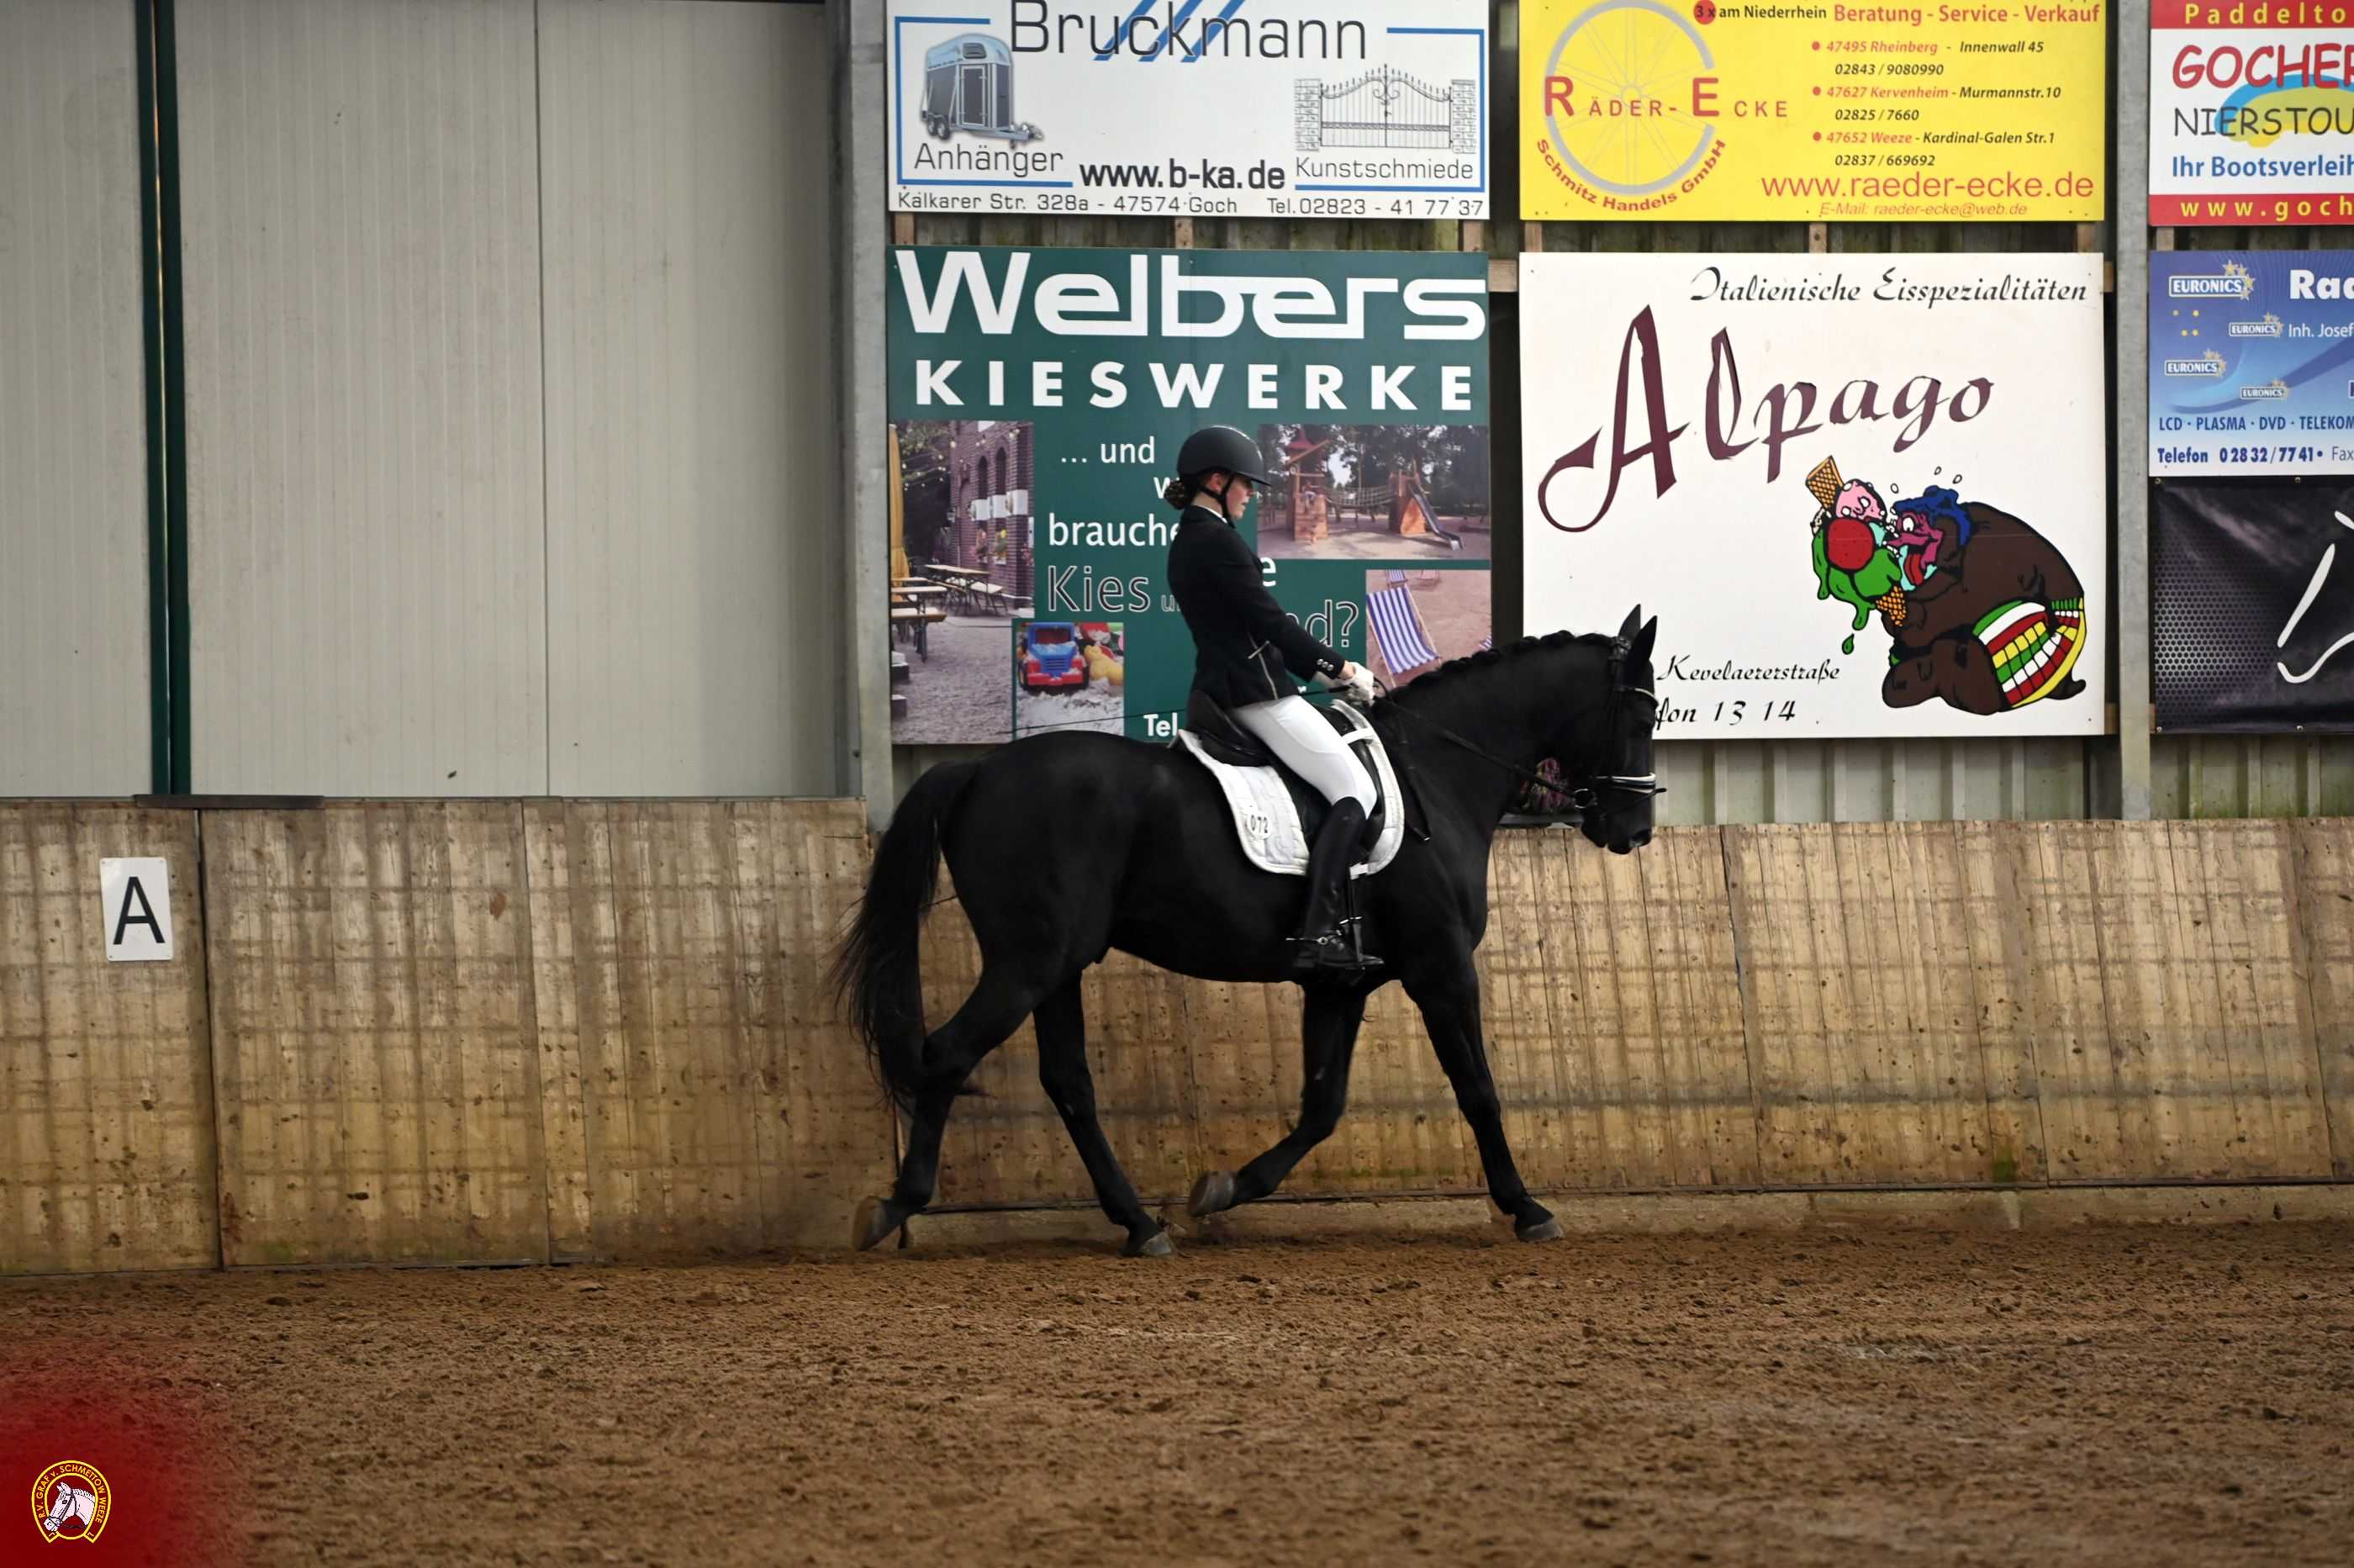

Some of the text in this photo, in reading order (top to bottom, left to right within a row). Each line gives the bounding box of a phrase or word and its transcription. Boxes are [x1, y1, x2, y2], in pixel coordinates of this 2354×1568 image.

[1697, 5, 1703, 18] 3
[1708, 8, 1716, 17] x
[1719, 8, 1740, 18] am
[1744, 5, 1827, 18] Niederrhein
[1834, 4, 1922, 26] Beratung
[1939, 5, 2008, 23] Service
[2024, 4, 2100, 23] Verkauf
[2185, 3, 2346, 24] Paddelto
[1011, 0, 1365, 59] Bruckmann
[1827, 41, 1867, 52] 47495
[1871, 40, 1938, 55] Rheinberg
[1960, 41, 2024, 53] Innenwall
[2028, 41, 2045, 52] 45
[1835, 64, 1875, 75] 02843
[1887, 64, 1944, 75] 9080990
[1827, 87, 1867, 98] 47627
[1871, 86, 1949, 98] Kervenheim
[1835, 109, 1875, 120] 02825
[1887, 109, 1919, 120] 7660
[1827, 132, 1867, 143] 47652
[1871, 132, 1913, 144] Weeze
[1923, 131, 2023, 144] Kardinal-Galen
[915, 143, 1063, 177] Anhänger
[1296, 156, 1473, 179] Kunstschmiede
[1835, 155, 1876, 166] 02837
[1887, 155, 1935, 166] 669692
[2172, 156, 2204, 177] Ihr
[1079, 158, 1285, 189] www.b-ka.de
[1538, 139, 1726, 211] Schmitz Handels GmbH
[1761, 171, 2094, 198] www.raeder-ecke.de
[898, 192, 981, 209] Kalkarer
[990, 194, 1026, 209] Str.
[1037, 194, 1089, 210] 328a
[1114, 197, 1180, 211] 47574
[1190, 197, 1238, 213] Goch
[1391, 200, 1413, 214] 41
[1425, 200, 1449, 215] 77
[1459, 200, 1483, 215] 37
[1820, 203, 2027, 217] E-Mail: raeder-ecke@web.de
[2180, 195, 2353, 221] www.goch
[895, 250, 1486, 341] Welbers
[1690, 267, 2087, 309] Italienische Eisspezialitäten
[2173, 280, 2242, 293] EURONICS
[2232, 325, 2275, 334] EURONICS
[2288, 323, 2354, 337] Inh. Josef
[2167, 362, 2218, 373] EURONICS
[916, 359, 1471, 410] KIESWERKE
[2243, 388, 2283, 398] EURONICS
[1538, 304, 1994, 531] Alpago
[2159, 418, 2182, 430] LCD
[2197, 417, 2246, 430] PLASMA
[2260, 416, 2286, 430] DVD
[1100, 436, 1154, 463] und
[2157, 446, 2209, 463] Telefon
[2332, 446, 2354, 461] Fax
[1048, 565, 1151, 612] Kies
[1656, 654, 1840, 684] Kevelaererstraße
[1714, 700, 1746, 726] 13
[1764, 700, 1796, 721] 14
[113, 876, 166, 944] A
